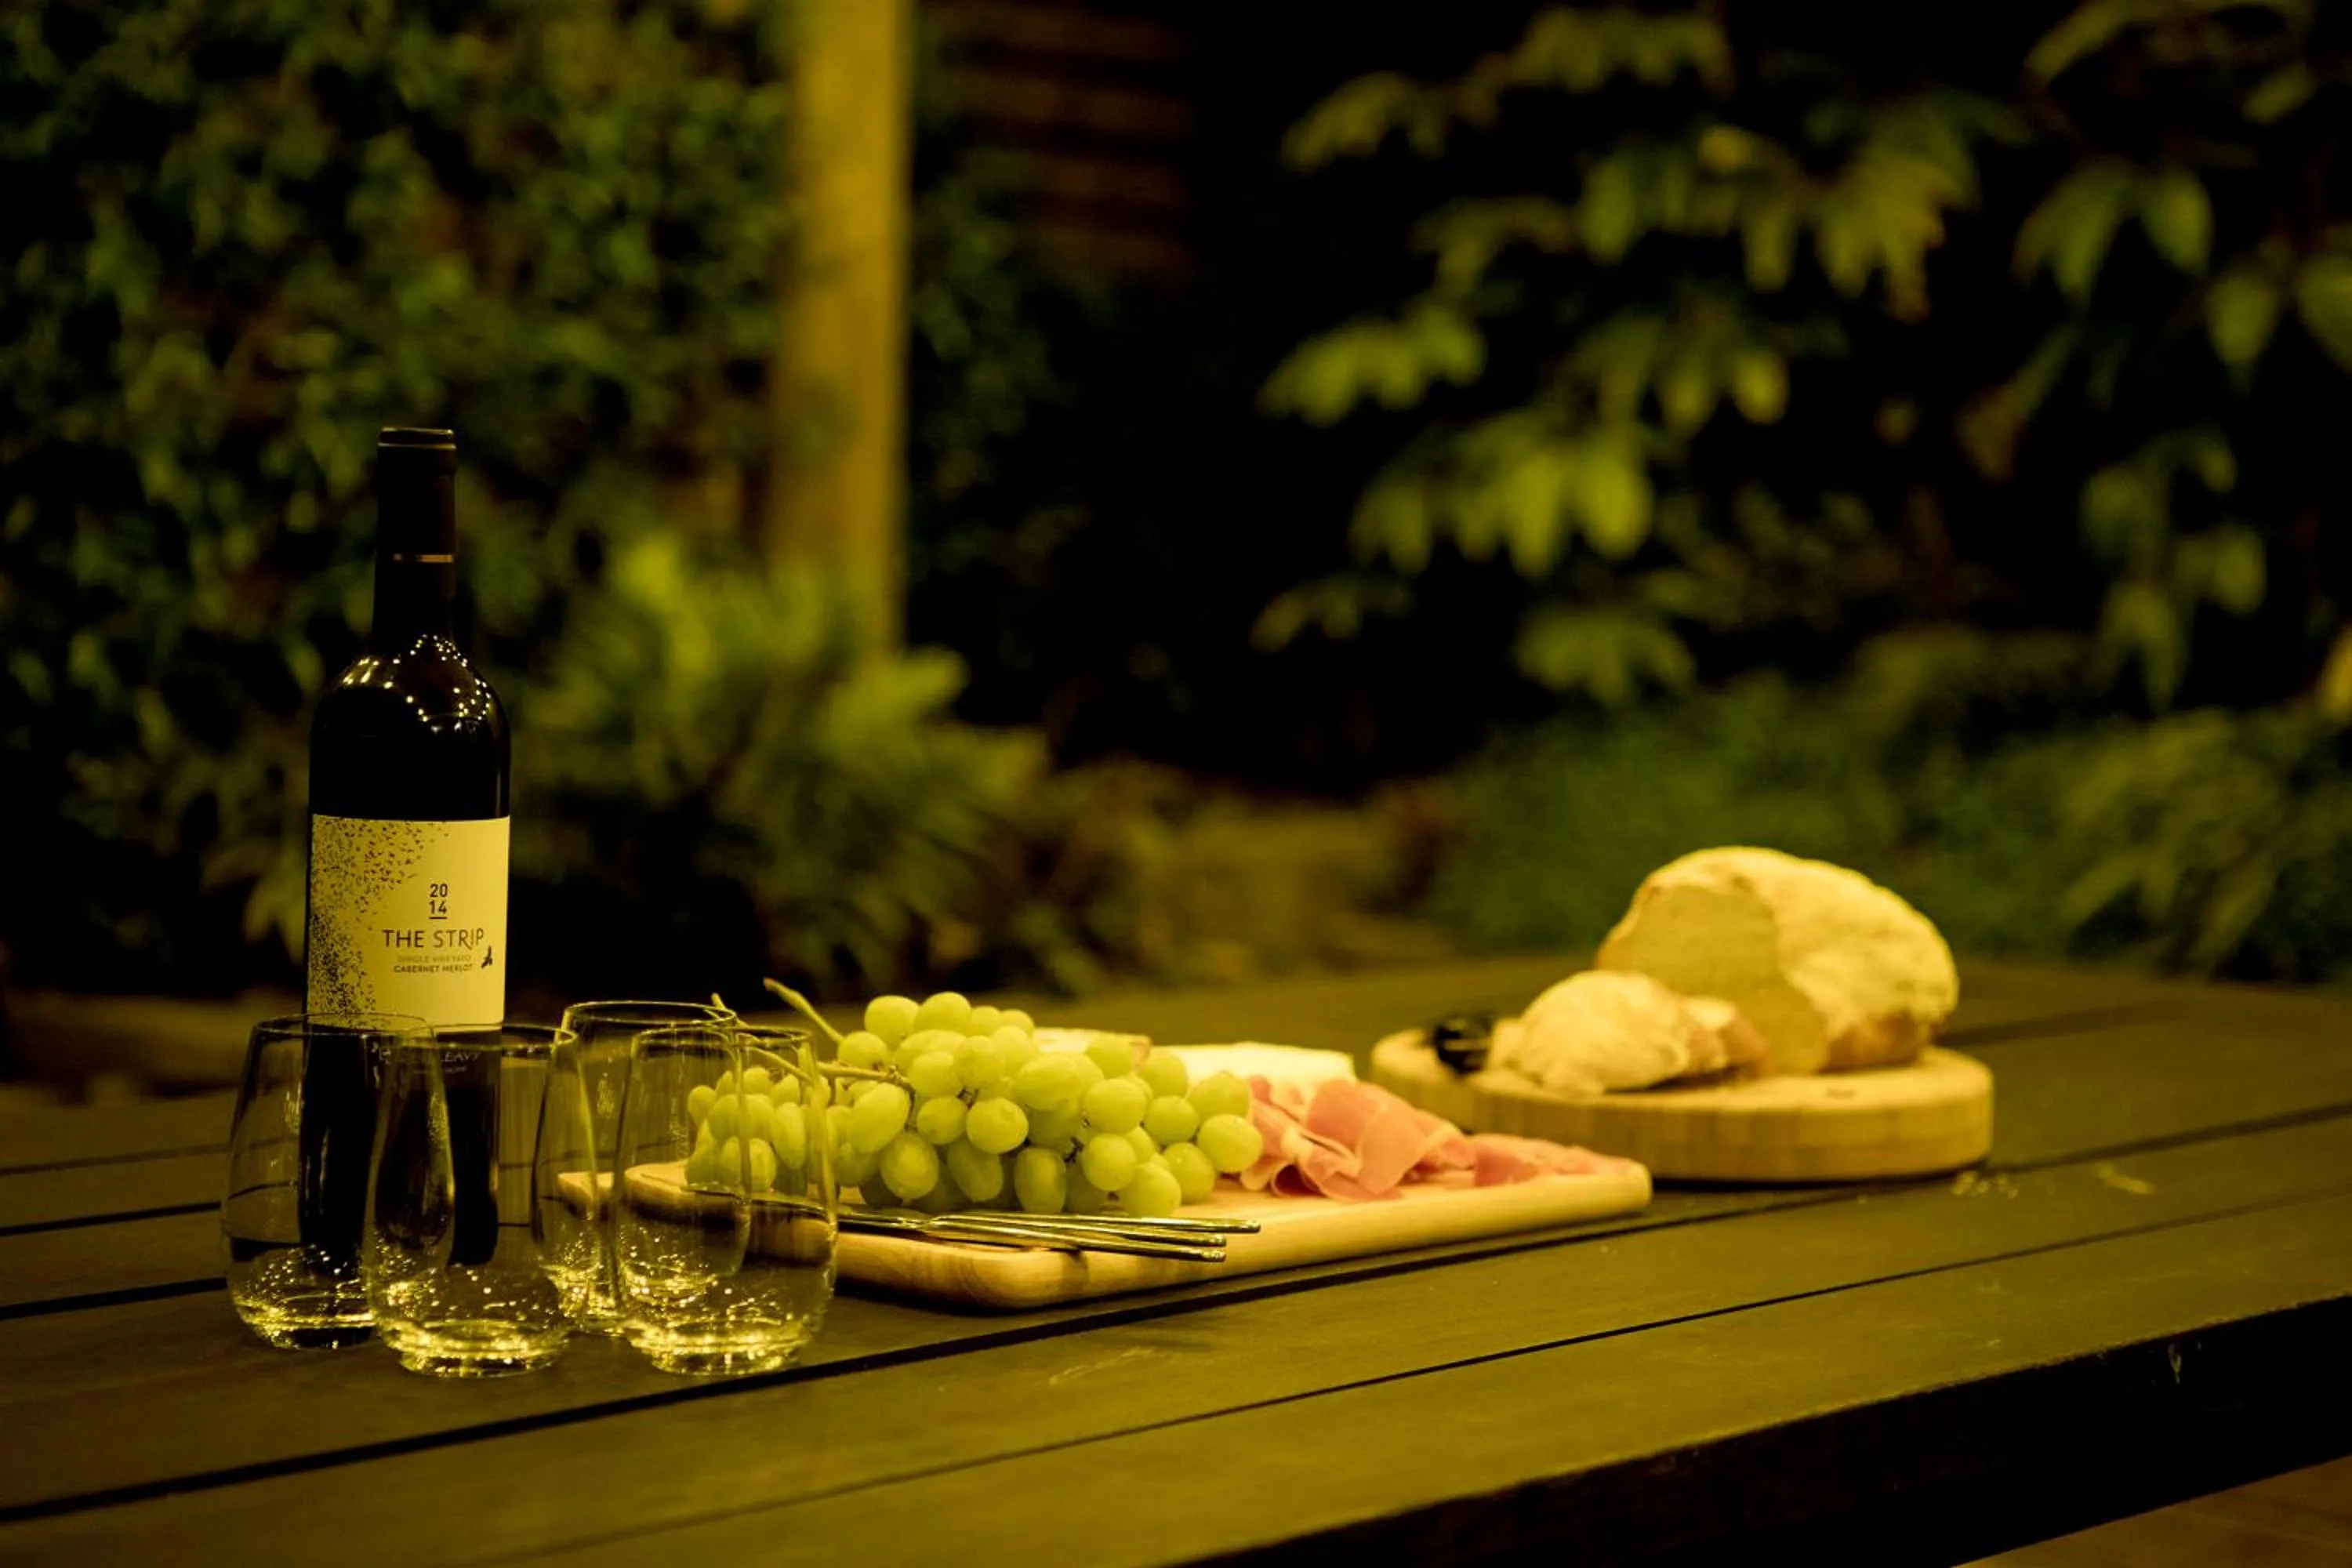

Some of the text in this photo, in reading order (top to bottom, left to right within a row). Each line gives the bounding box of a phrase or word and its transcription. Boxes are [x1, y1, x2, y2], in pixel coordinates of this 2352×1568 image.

[430, 884, 448, 898] 20
[429, 899, 447, 914] 14
[383, 927, 485, 950] THE STRIP
[441, 964, 474, 972] MERLOT
